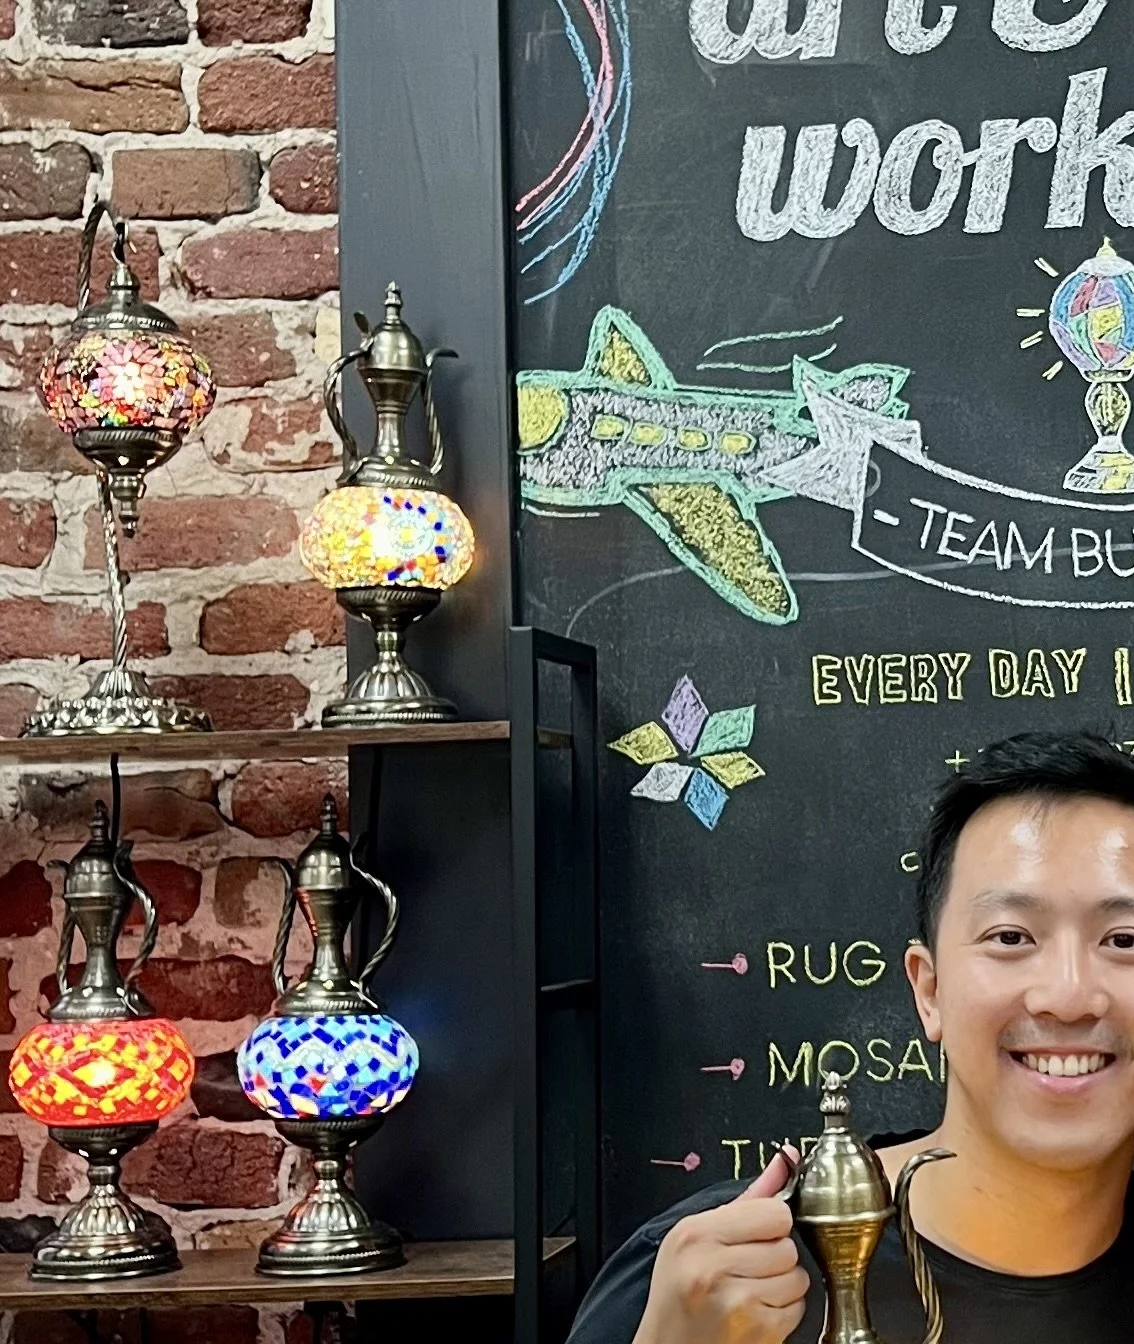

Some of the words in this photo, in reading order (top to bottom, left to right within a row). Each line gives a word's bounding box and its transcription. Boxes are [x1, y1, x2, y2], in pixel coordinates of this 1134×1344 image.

[908, 497, 1055, 575] TEAM
[810, 651, 973, 706] EVERY
[987, 646, 1087, 699] DAY
[766, 939, 887, 989] RUG
[767, 1037, 947, 1088] MOSAI
